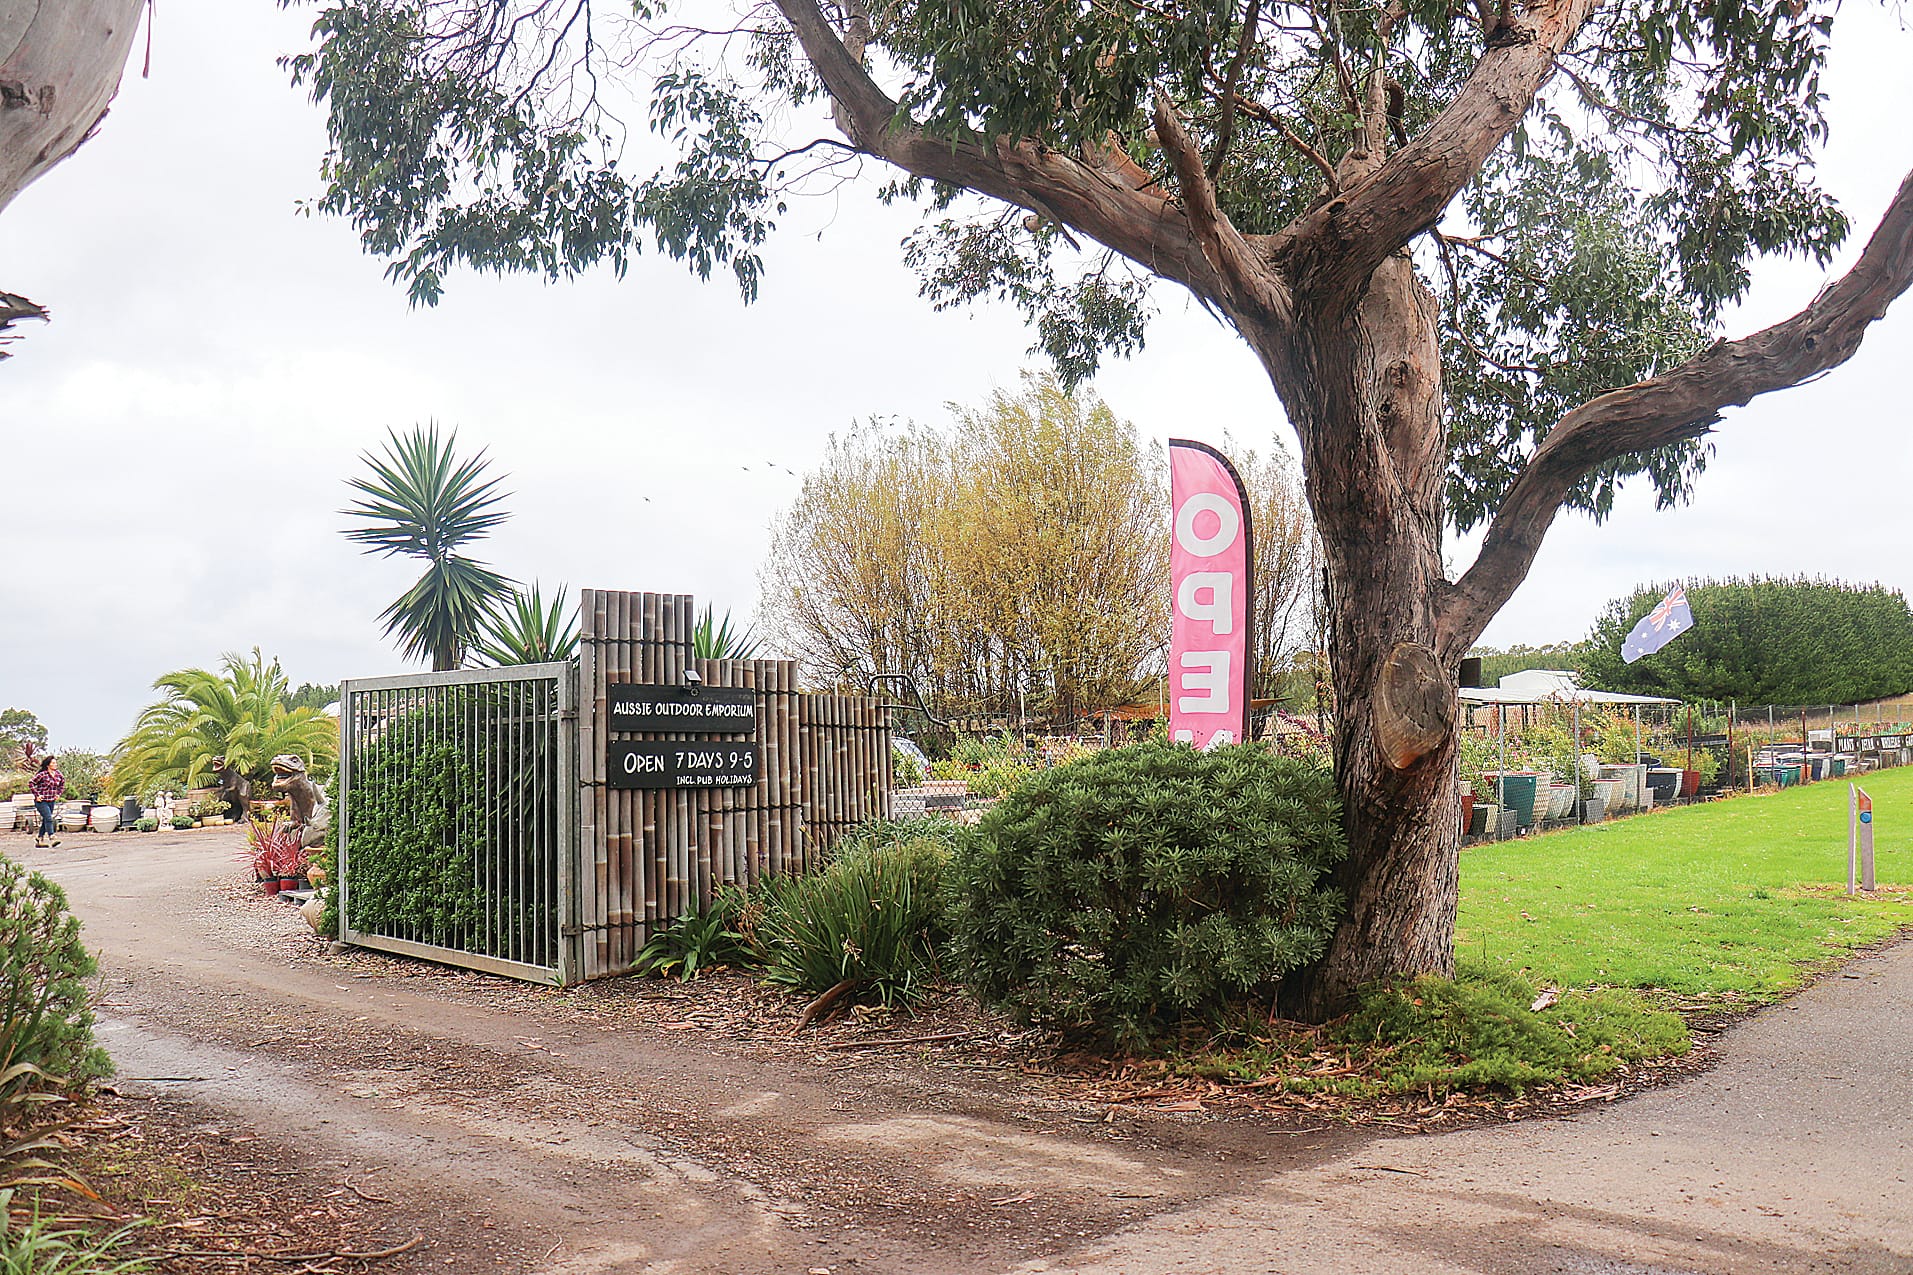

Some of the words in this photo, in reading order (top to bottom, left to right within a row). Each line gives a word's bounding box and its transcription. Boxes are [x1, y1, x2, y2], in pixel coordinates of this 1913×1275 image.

[613, 702, 652, 715] AUSSIE
[655, 703, 704, 717] OUTDOOR
[705, 704, 754, 718] EMPORIUM
[623, 752, 665, 774] OPEN
[675, 752, 685, 769] 7
[687, 751, 724, 769] DAYS
[729, 751, 753, 769] 9-5
[696, 775, 713, 785] PUB
[715, 774, 753, 785] HOLIDAYS
